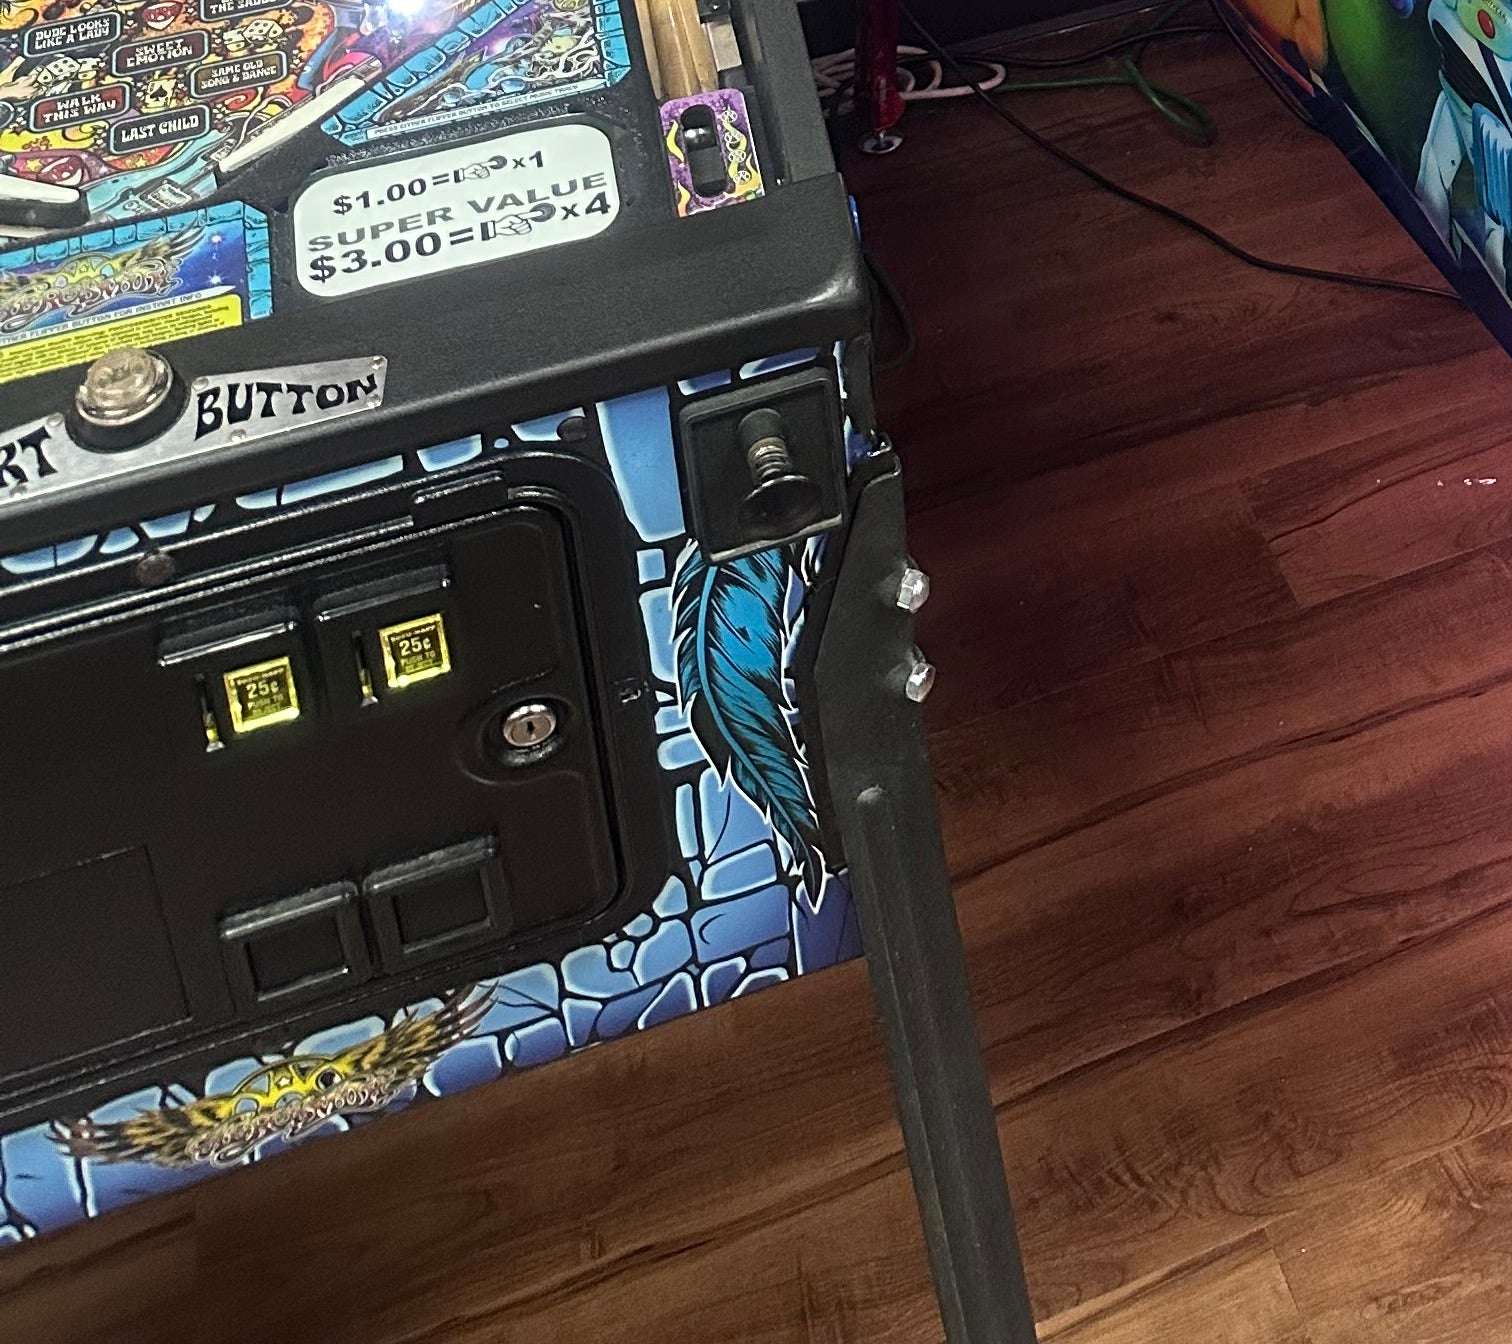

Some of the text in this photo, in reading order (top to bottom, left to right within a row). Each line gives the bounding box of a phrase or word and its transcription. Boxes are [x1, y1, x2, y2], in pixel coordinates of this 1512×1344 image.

[209, 1, 236, 15] THE
[35, 17, 111, 41] DUDE LOOKS
[35, 25, 111, 51] LIKE A LADY
[126, 46, 194, 68] EMOTION
[134, 38, 185, 56] SWEET
[200, 74, 230, 91] SONG
[242, 65, 278, 82] DANCE
[211, 59, 264, 79] SAME OLD
[43, 99, 118, 125] THIS WAY
[56, 93, 102, 111] WALK
[121, 114, 200, 143] LAST CHILD
[308, 171, 608, 253] SUPER VALUE
[194, 373, 379, 441] BUTTON
[399, 637, 432, 656] 25¢
[246, 679, 280, 699] 25¢
